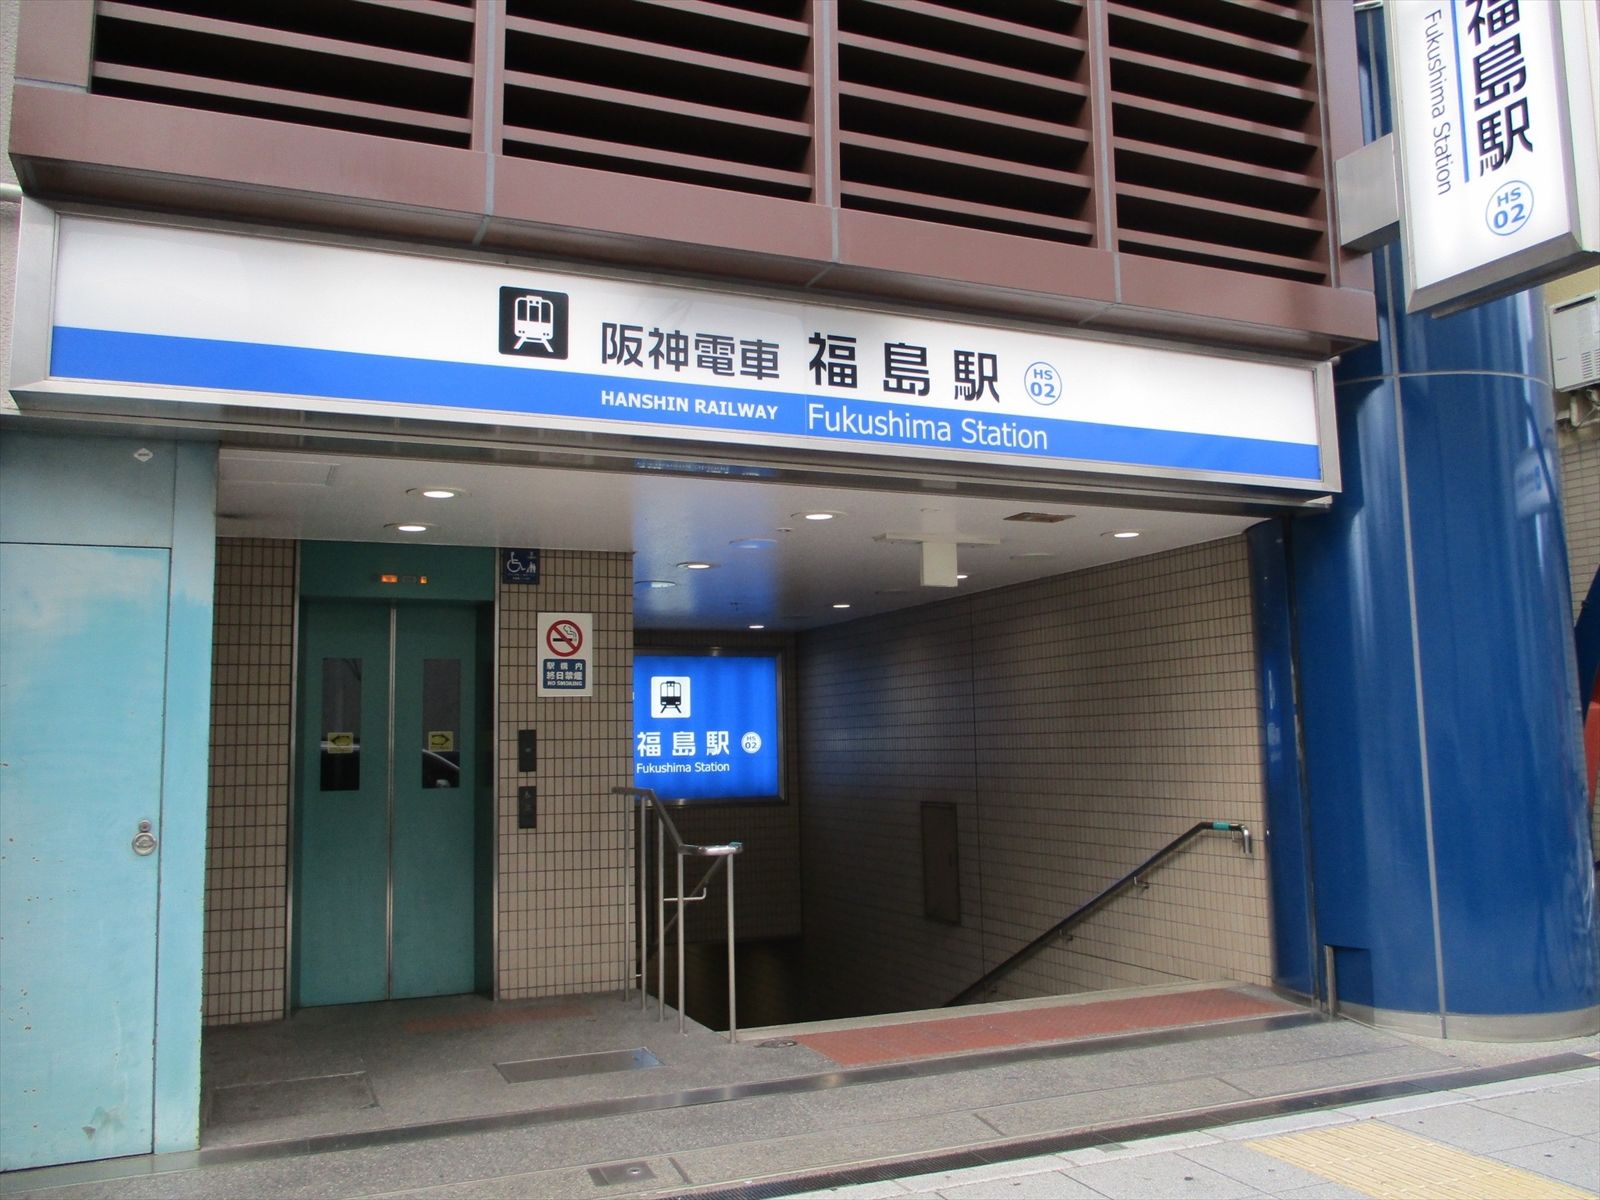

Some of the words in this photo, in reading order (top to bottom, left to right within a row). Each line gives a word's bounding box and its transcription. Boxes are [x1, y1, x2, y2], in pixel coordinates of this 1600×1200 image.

[1425, 9, 1448, 119] Fukushima
[1433, 121, 1453, 196] Station
[1496, 187, 1522, 207] HS
[1493, 203, 1526, 229] 02
[601, 322, 780, 380] 阪神電車
[808, 332, 1000, 403] 福島駅
[1033, 368, 1053, 381] HS
[1030, 381, 1056, 398] 02
[601, 390, 689, 412] HANSHIN
[695, 399, 778, 420] RAILWAY
[808, 403, 952, 442] Fukushima
[961, 418, 1048, 450] Station
[637, 730, 730, 757] 福島駅
[744, 741, 758, 749] 02
[636, 763, 692, 773] Fukushima
[694, 762, 730, 773] Station
